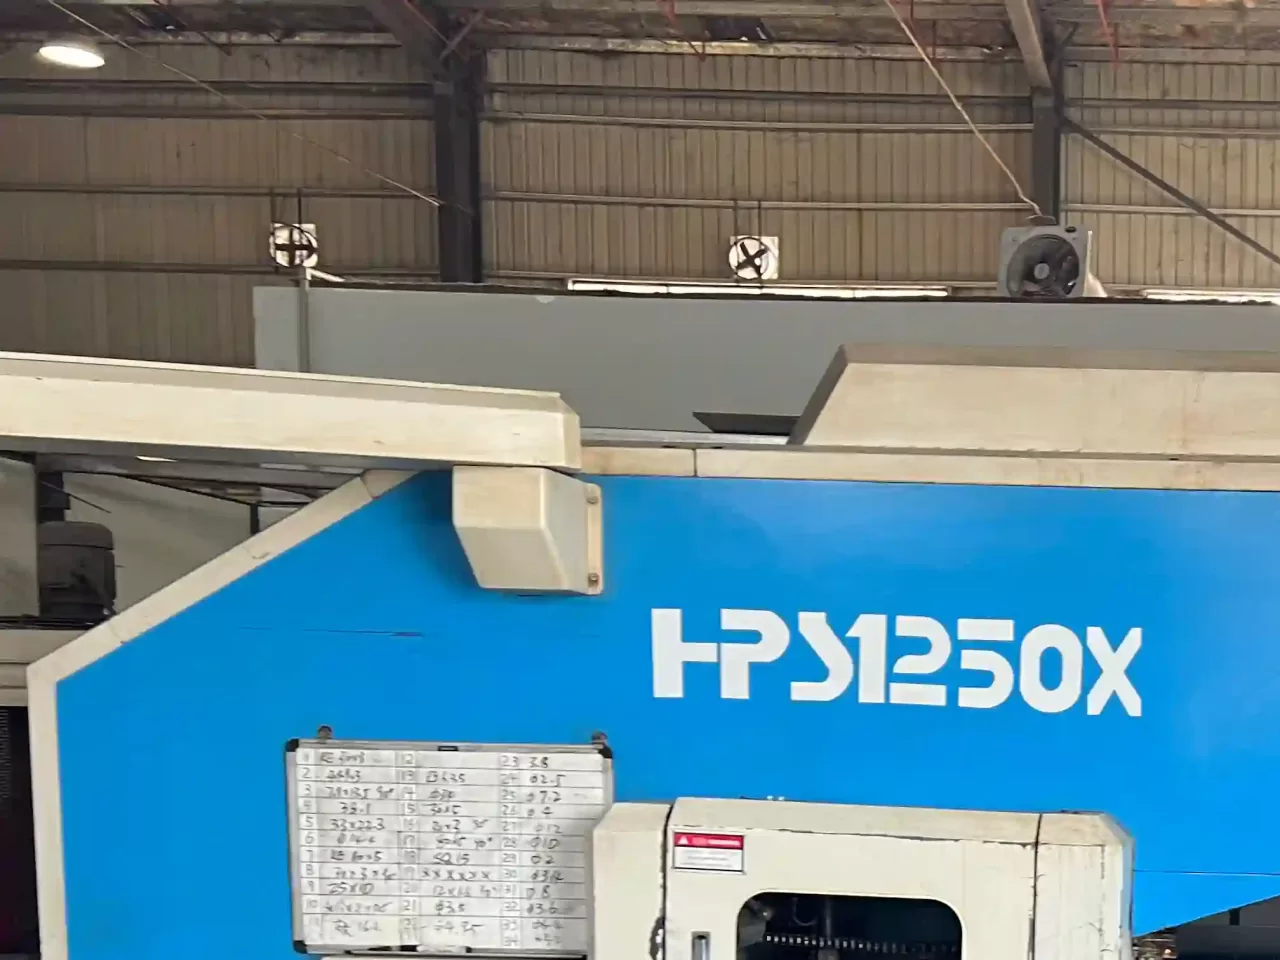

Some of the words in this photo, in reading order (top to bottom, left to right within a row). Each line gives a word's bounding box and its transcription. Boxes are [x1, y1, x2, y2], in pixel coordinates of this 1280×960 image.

[652, 609, 1141, 716] HPS1250X
[302, 767, 312, 779] 2
[304, 816, 314, 828] 5
